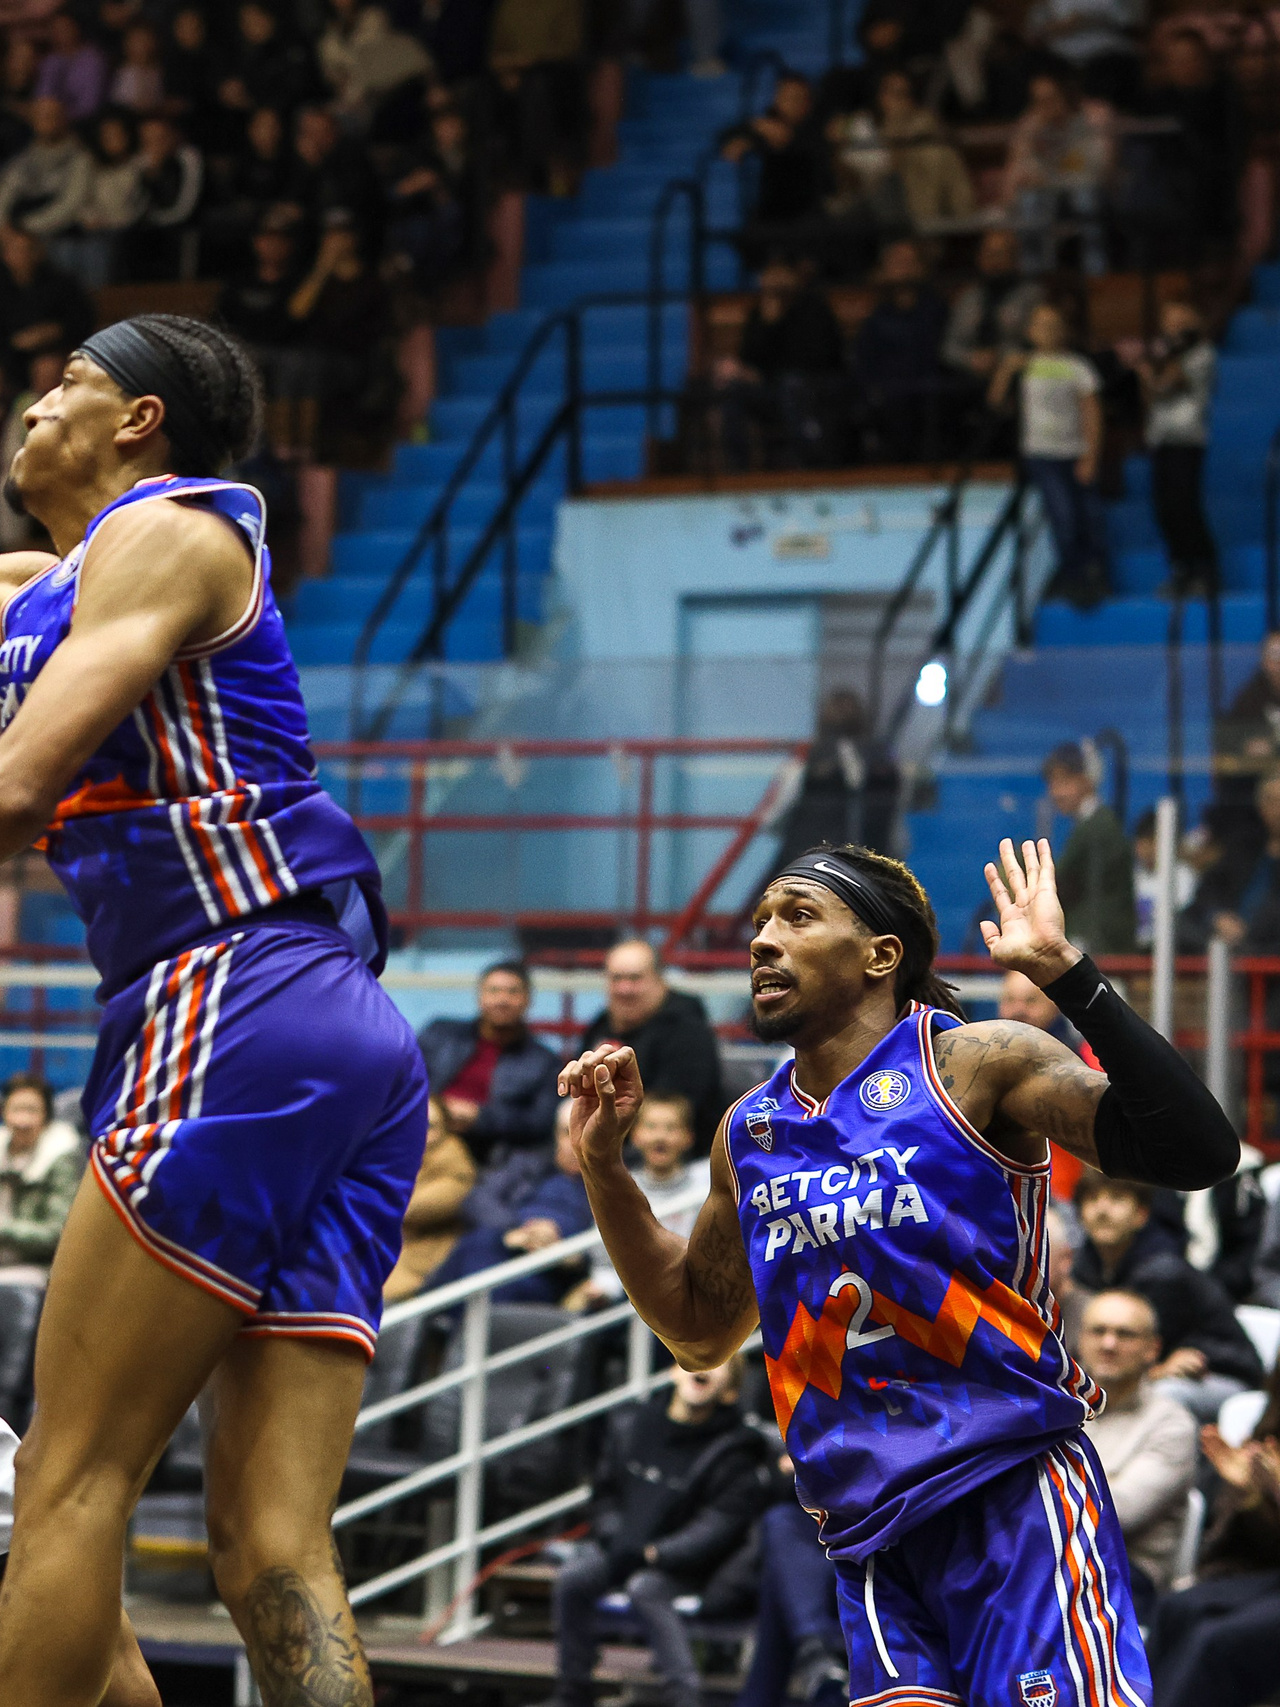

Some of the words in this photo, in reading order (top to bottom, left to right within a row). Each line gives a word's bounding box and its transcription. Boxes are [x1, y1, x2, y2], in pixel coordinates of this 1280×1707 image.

[750, 1146, 920, 1217] BETCITY
[764, 1184, 929, 1262] PARMA
[828, 1271, 896, 1350] 2
